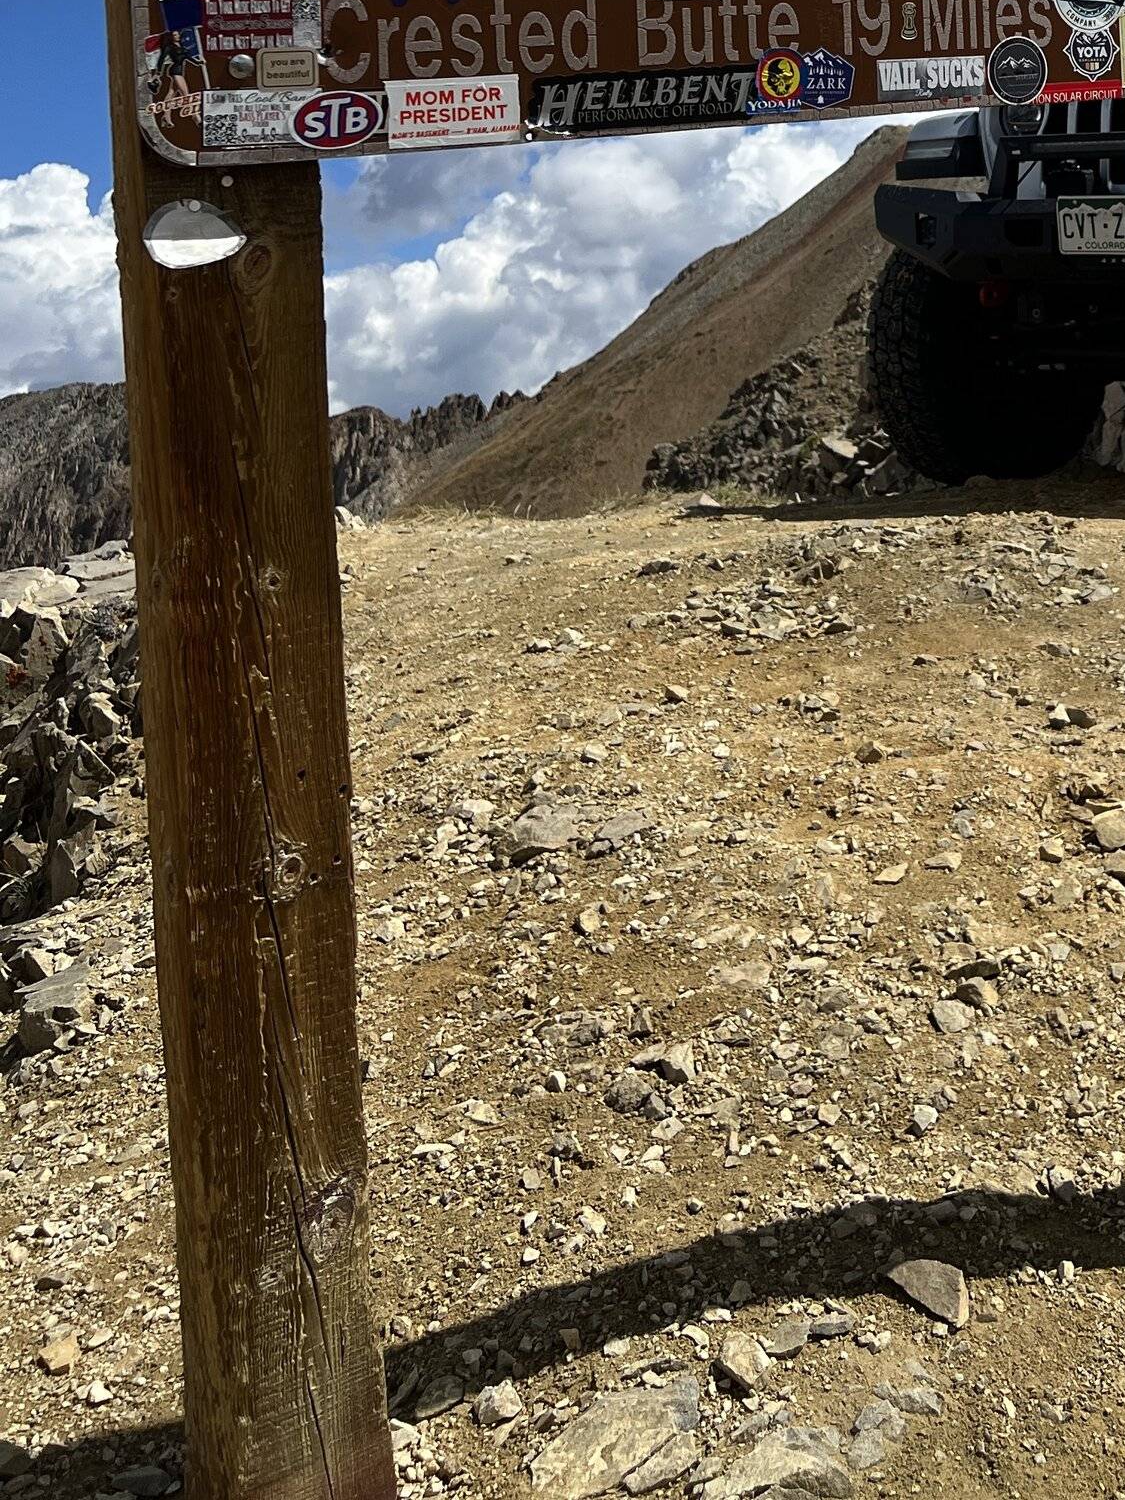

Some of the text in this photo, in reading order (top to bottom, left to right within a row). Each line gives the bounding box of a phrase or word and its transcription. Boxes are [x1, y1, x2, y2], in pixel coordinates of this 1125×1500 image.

[1065, 9, 1099, 28] COMPANY
[1076, 45, 1109, 59] YOTA
[270, 57, 306, 67] you are
[266, 69, 311, 80] beautiful
[877, 56, 986, 92] VAIL SUCKS
[244, 91, 279, 104] Cool
[405, 87, 503, 107] MOM FOR
[537, 71, 756, 128] HELLBENT
[1053, 88, 1118, 104] SOLAR CIRCUIT
[577, 101, 735, 124] PERFORMANCE OFF ROAD
[746, 99, 786, 112] YODA
[303, 96, 370, 140] STB
[400, 104, 508, 126] PRESIDENT
[490, 124, 522, 134] ALABAMA
